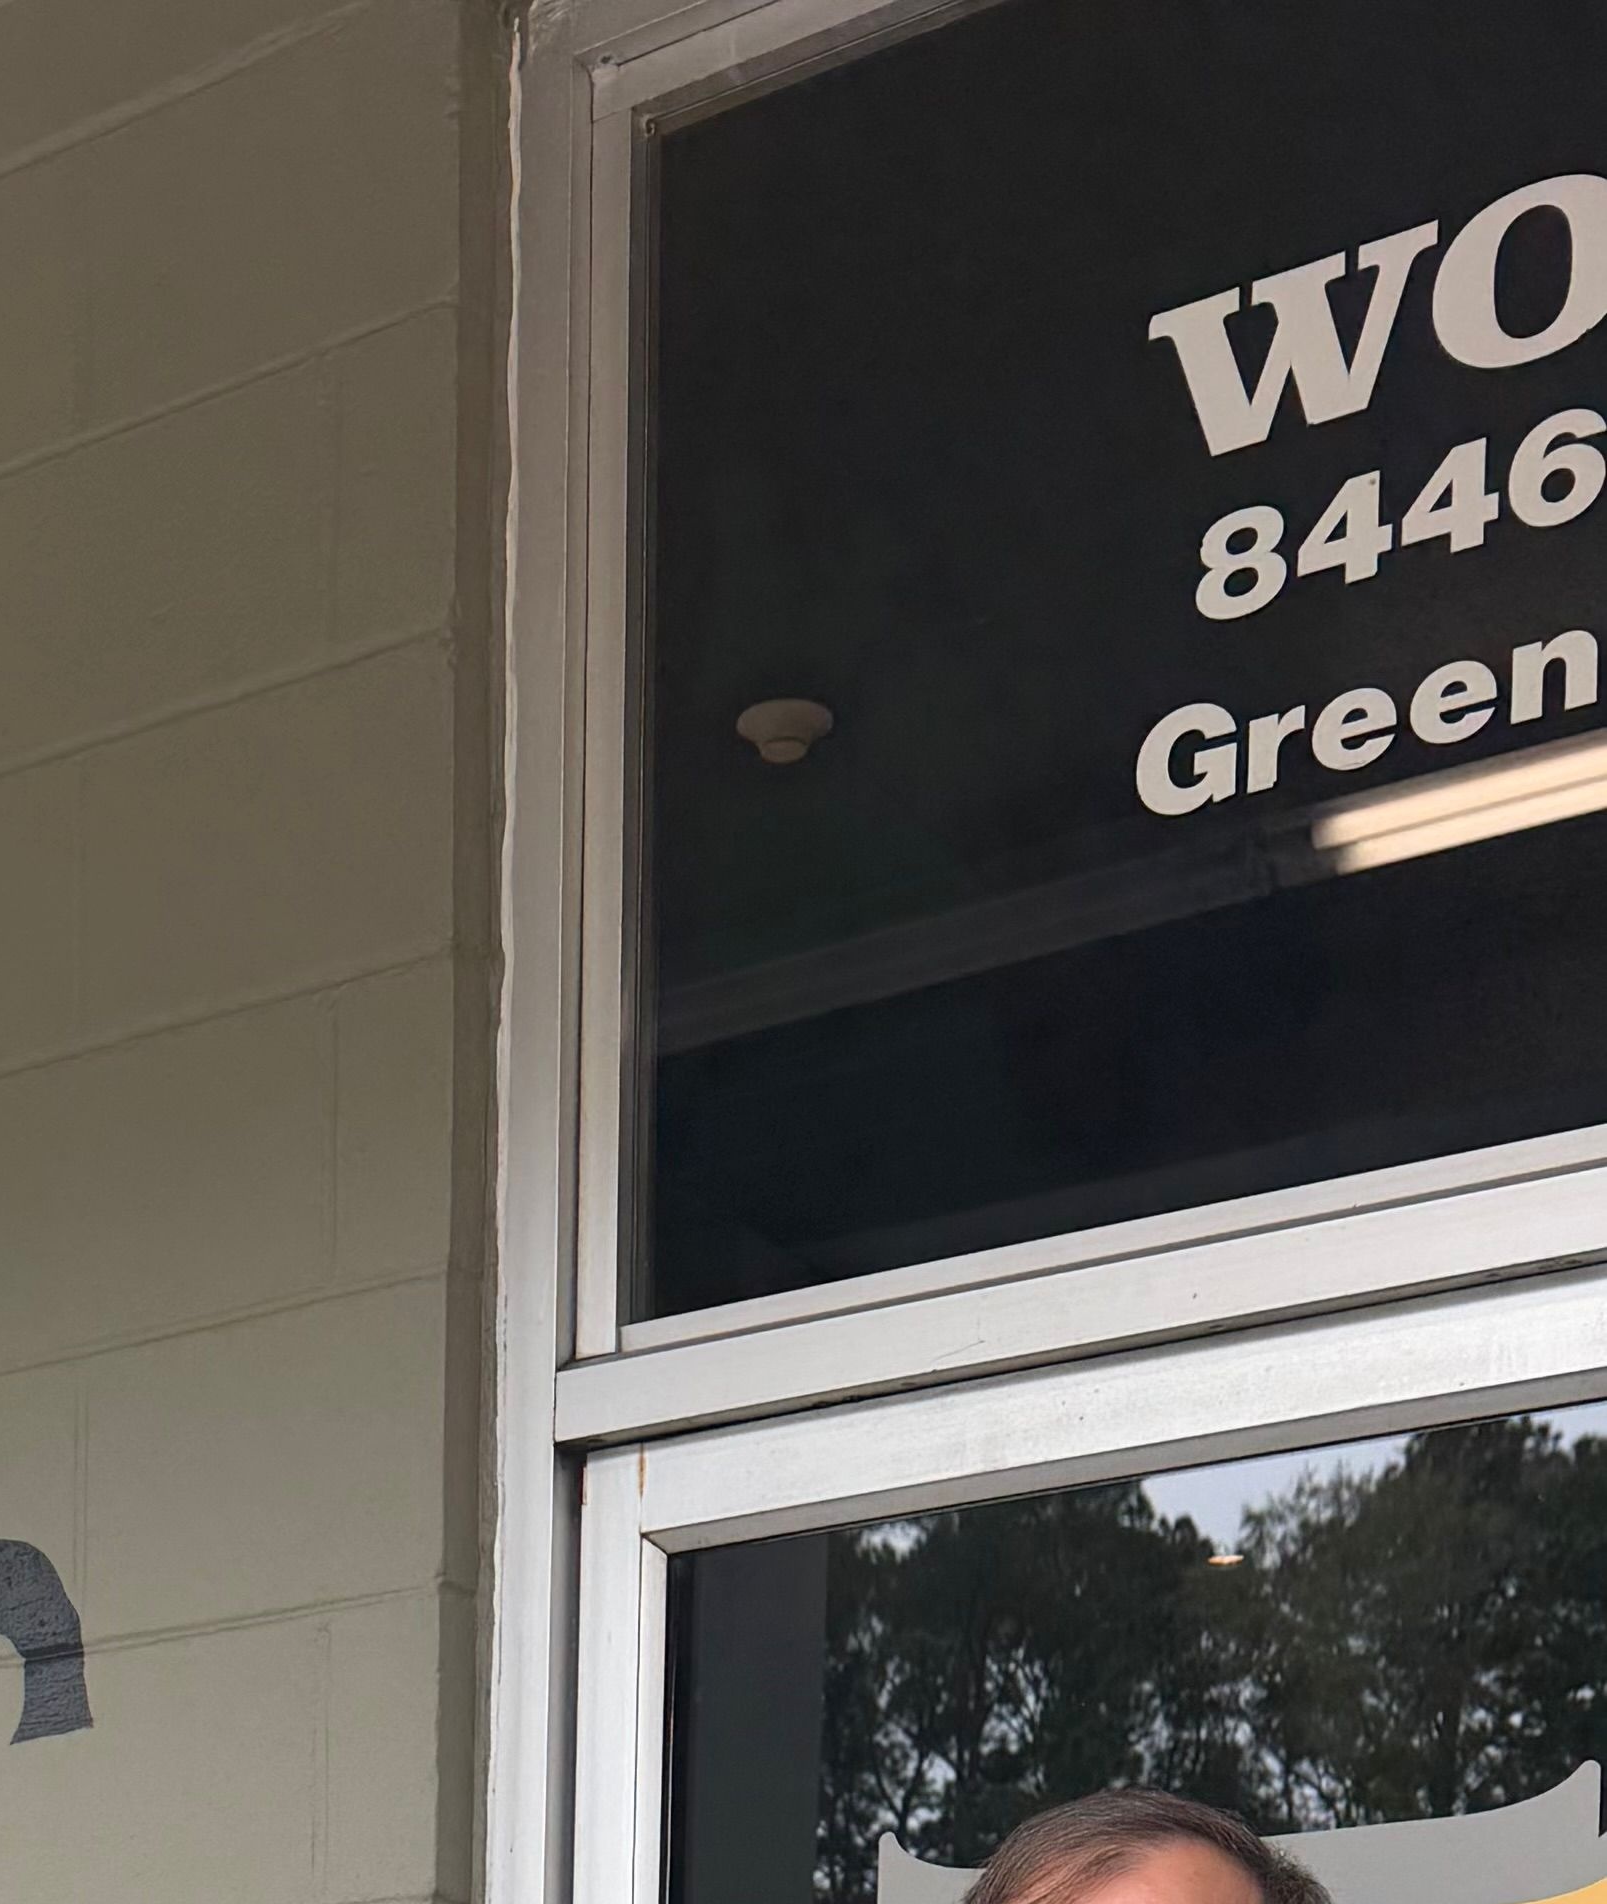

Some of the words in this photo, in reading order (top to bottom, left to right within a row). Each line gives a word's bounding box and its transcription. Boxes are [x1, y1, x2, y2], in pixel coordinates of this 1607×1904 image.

[1149, 174, 1607, 457] WO
[1195, 408, 1607, 620] 8446
[1135, 629, 1598, 815] Green
